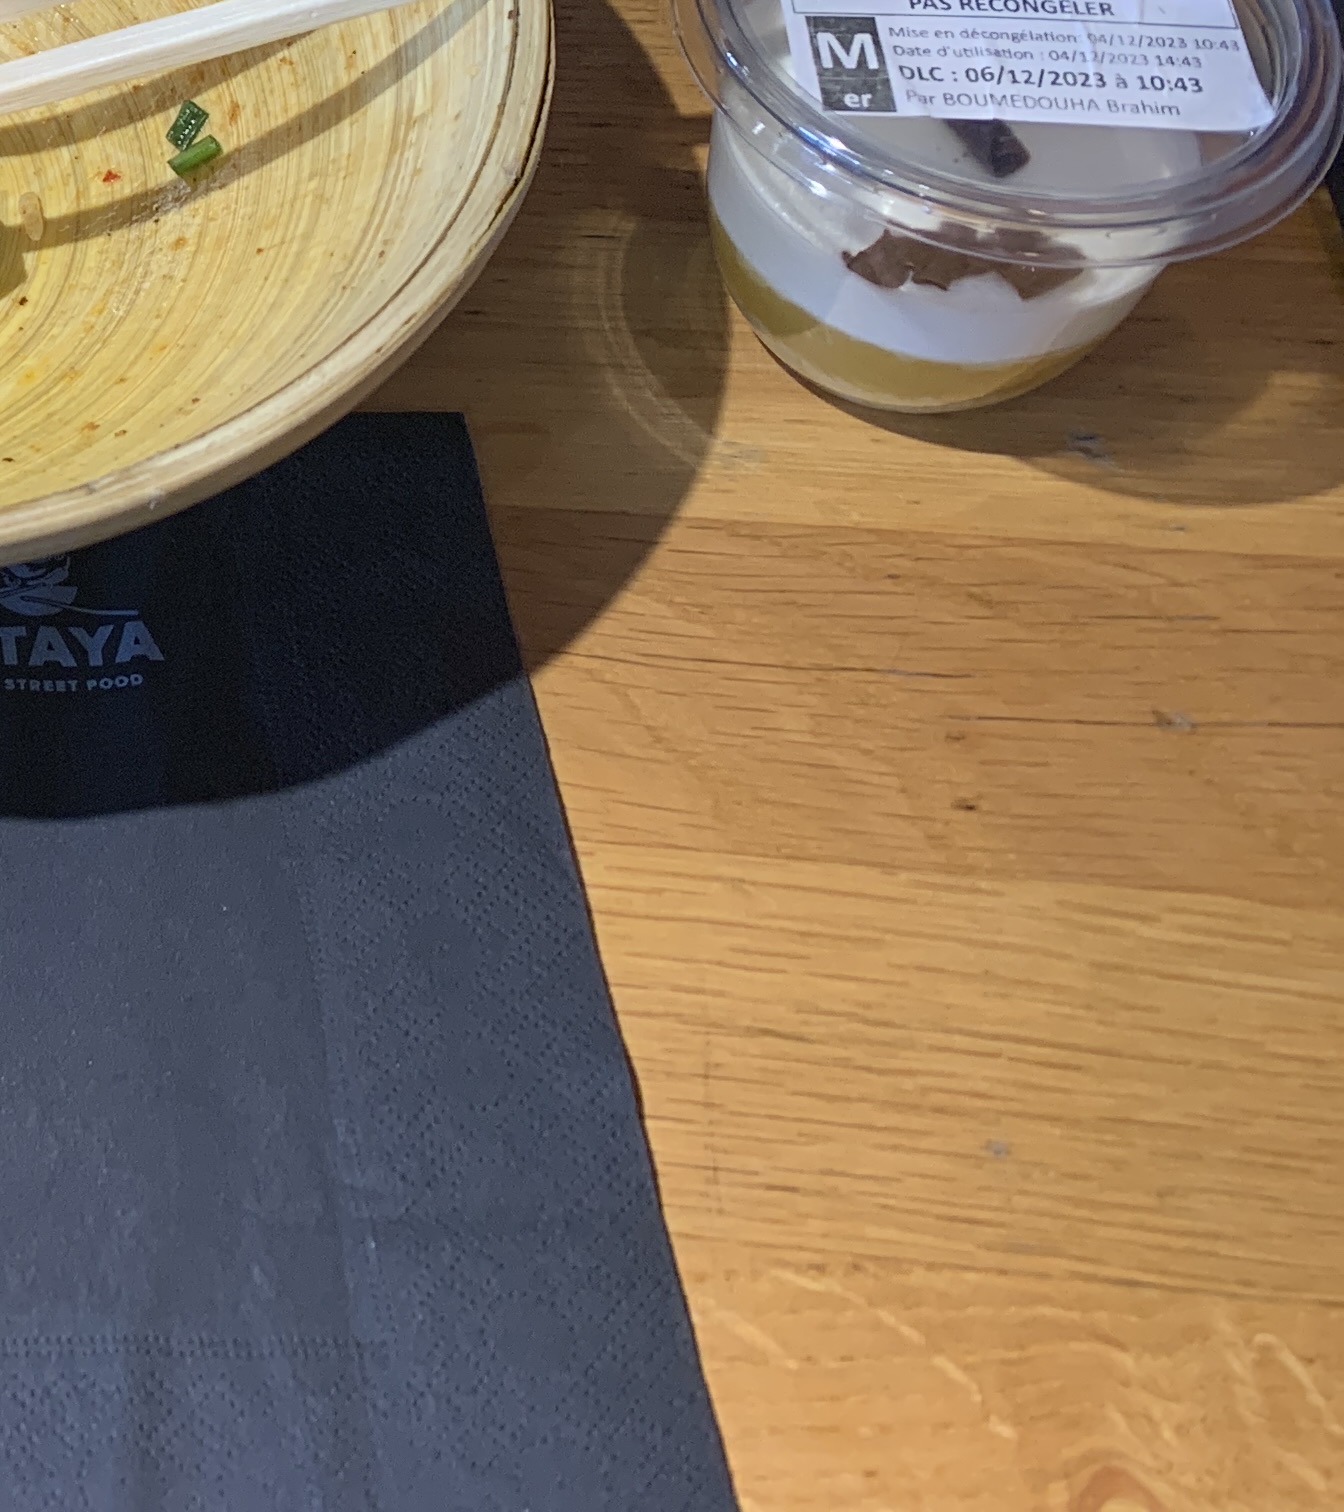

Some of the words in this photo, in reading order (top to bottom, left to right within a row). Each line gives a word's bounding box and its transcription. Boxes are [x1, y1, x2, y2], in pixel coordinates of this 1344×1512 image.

[816, 32, 879, 70] M
[888, 25, 930, 40] Mise
[934, 29, 956, 39] en
[1087, 31, 1188, 50] 04/12/2023
[1194, 38, 1241, 52] 10:43
[892, 44, 932, 57] Date
[937, 44, 1035, 61] d'utilisation
[1048, 49, 1150, 67] 04/12/2023
[1155, 53, 1204, 69] 14:43
[898, 64, 945, 83] DLC
[965, 65, 1107, 90] 06/12/2023
[1114, 73, 1129, 90] à
[1136, 75, 1204, 94] 10:43
[843, 92, 873, 108] er
[905, 89, 936, 107] Par
[943, 92, 1101, 113] BOUMEDOUHA
[1107, 100, 1182, 117] Brahim
[4, 678, 78, 692] STREET
[86, 673, 144, 691] FOOD
